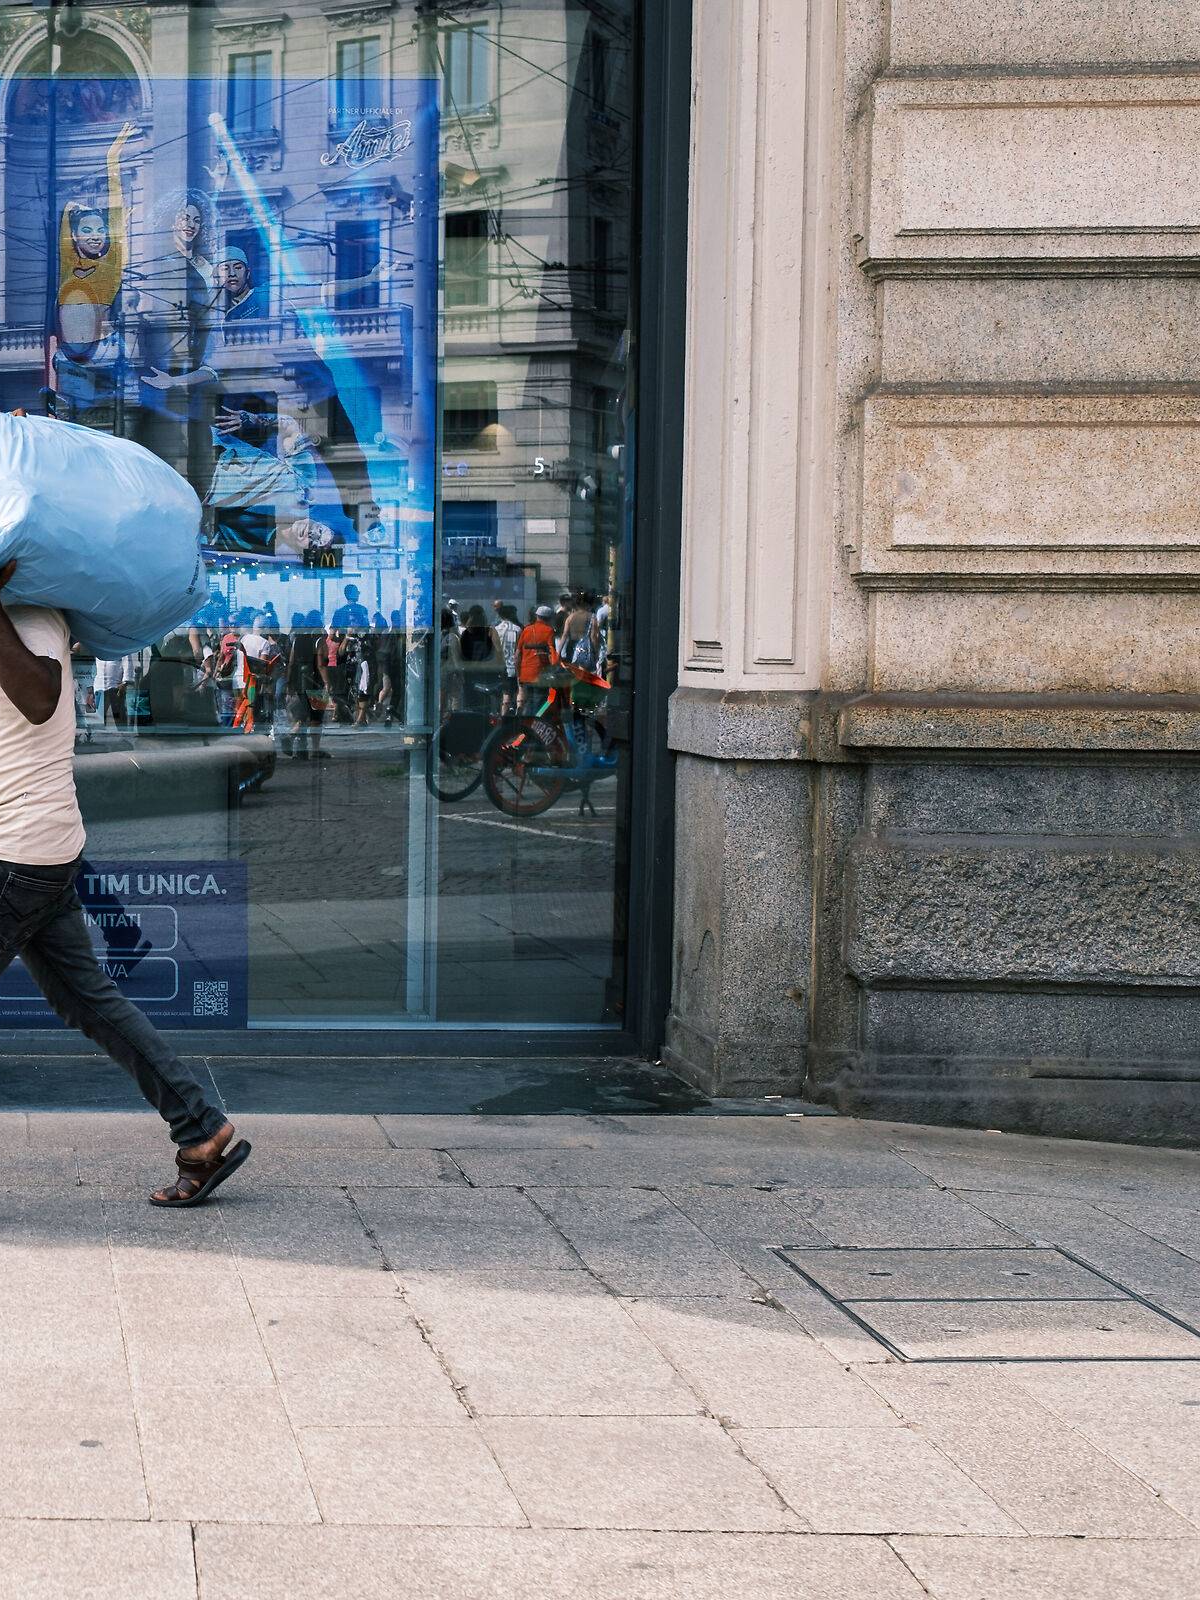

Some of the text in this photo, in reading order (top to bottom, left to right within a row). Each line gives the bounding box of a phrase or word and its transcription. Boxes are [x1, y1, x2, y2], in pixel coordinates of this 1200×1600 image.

[320, 119, 412, 170] Amici
[83, 874, 130, 895] TIM
[137, 874, 227, 895] UNICA.
[83, 913, 141, 927] IMITATI
